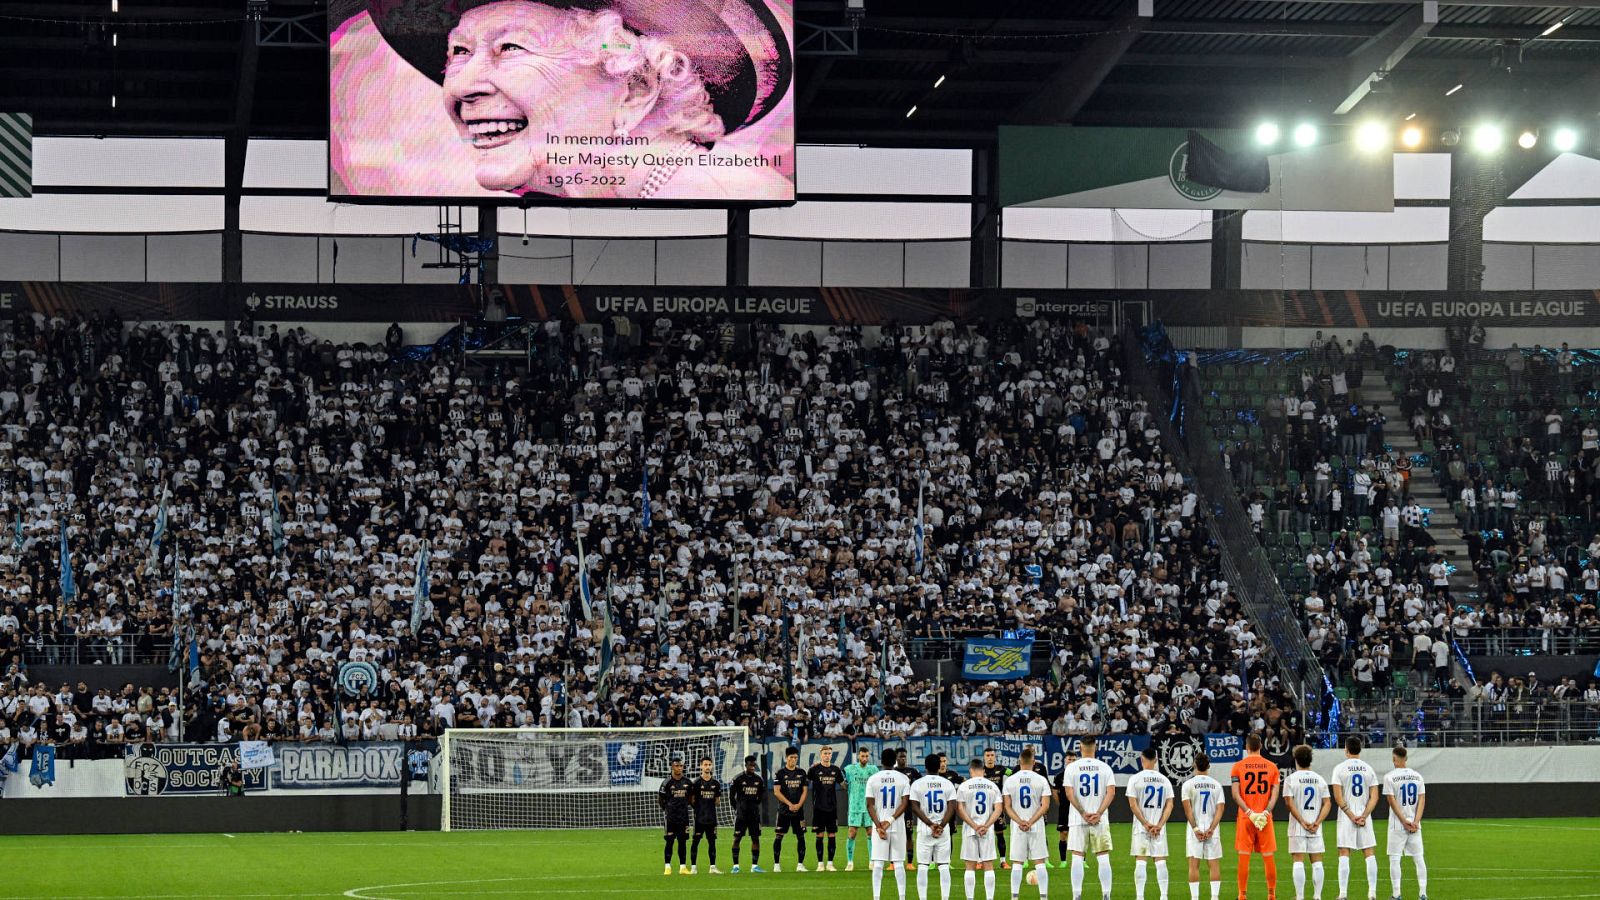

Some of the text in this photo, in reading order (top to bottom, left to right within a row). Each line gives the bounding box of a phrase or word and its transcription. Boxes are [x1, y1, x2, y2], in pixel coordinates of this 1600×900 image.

[546, 132, 649, 146] In memoriam
[546, 152, 782, 169] Her Majesty Queen Elizabeth II
[546, 174, 626, 188] 1926-2022
[265, 295, 338, 309] STRAUSS
[595, 296, 811, 314] UEFA EUROPA LEAGUE
[1018, 300, 1109, 316] enterprise
[1377, 301, 1584, 317] UEFA EUROPA LEAGUE
[995, 741, 1021, 753] BISCH
[1207, 736, 1239, 747] FREE
[1210, 747, 1240, 758] GABO
[282, 748, 401, 781] PARADOX
[1170, 745, 1194, 769] 43
[1079, 773, 1099, 797] 31
[1244, 771, 1269, 795] 25
[1351, 773, 1363, 797] 8
[1400, 782, 1418, 807] 19
[880, 785, 896, 809] 11
[925, 790, 944, 814] 15
[975, 791, 987, 815] 3
[1019, 785, 1032, 809] 6
[1144, 785, 1164, 809] 21
[1200, 791, 1211, 814] 7
[1303, 786, 1315, 810] 2
